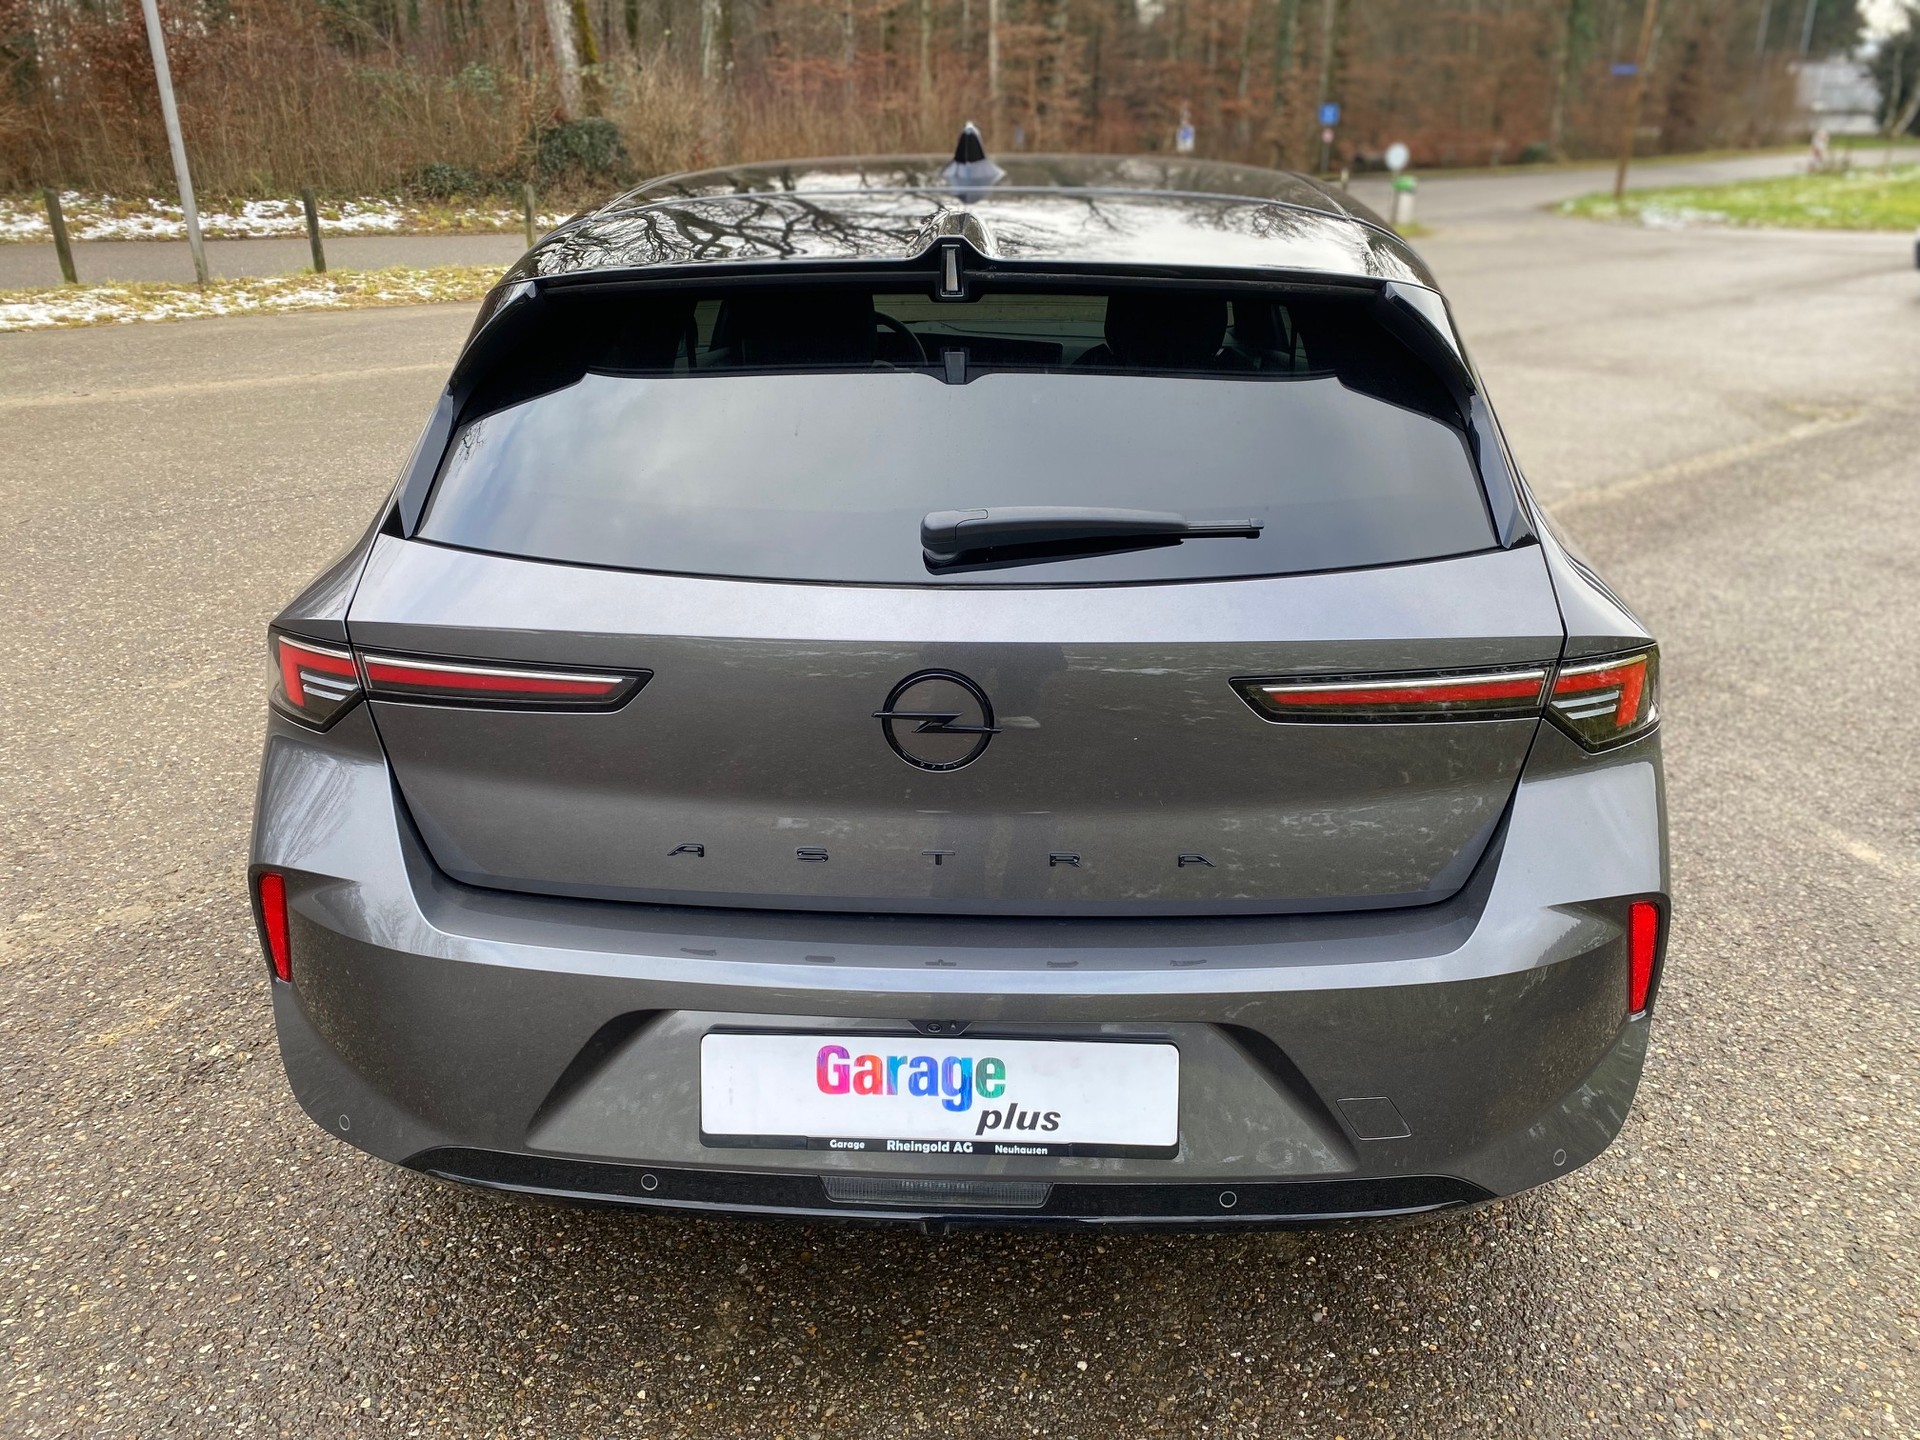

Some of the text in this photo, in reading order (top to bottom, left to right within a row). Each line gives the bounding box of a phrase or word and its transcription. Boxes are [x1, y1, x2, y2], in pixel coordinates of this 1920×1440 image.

[667, 843, 1216, 868] ASTRA
[816, 1045, 1006, 1112] Garage
[975, 1102, 1062, 1136] plus
[829, 1139, 1049, 1156] Garage Rheingold AG Neuhausen
